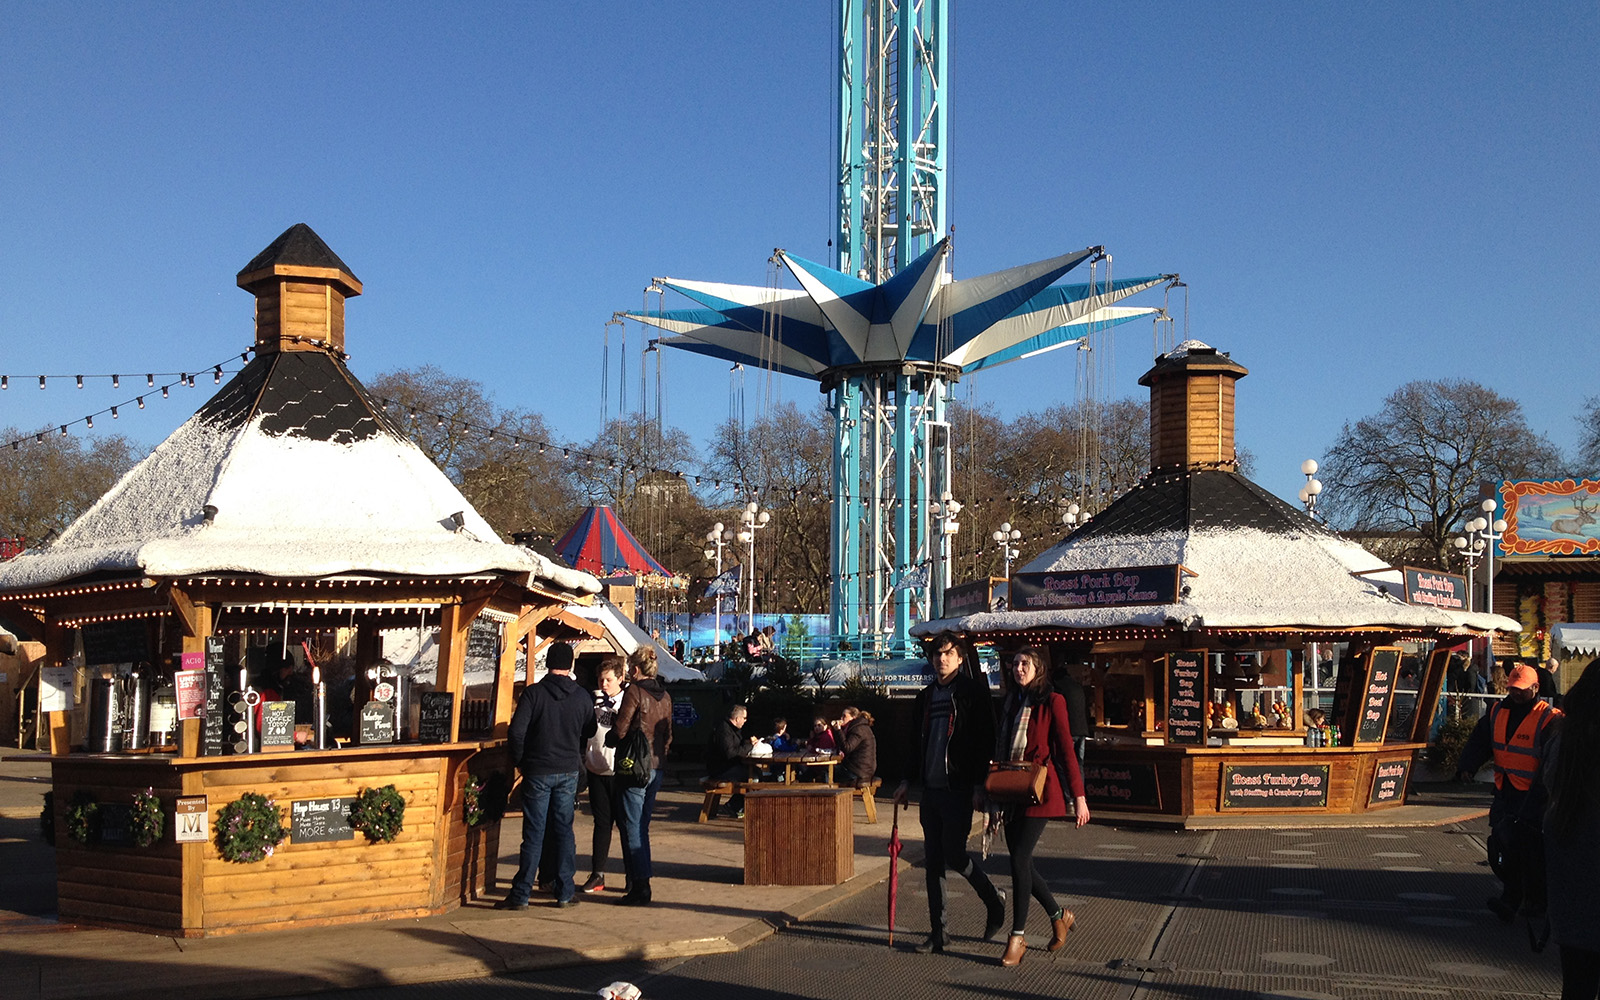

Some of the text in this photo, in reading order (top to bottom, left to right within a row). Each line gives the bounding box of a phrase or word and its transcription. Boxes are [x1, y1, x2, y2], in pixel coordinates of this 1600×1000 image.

[1044, 572, 1140, 590] Roast Pork Bap
[1417, 573, 1454, 593] Roast Pork Bap
[1026, 589, 1158, 607] with Stuffing & Apple Sauce
[1176, 659, 1197, 668] Roast
[884, 674, 897, 682] FOR
[898, 674, 911, 682] THE
[1174, 669, 1199, 678] Turkey
[1375, 671, 1388, 681] Hot
[1179, 679, 1194, 688] Bap
[379, 688, 390, 698] 13
[1178, 689, 1195, 698] with
[1369, 684, 1388, 694] Roast
[1172, 699, 1200, 708] Stuffing
[1368, 696, 1384, 707] Beef
[1366, 709, 1380, 721] Bap
[1169, 718, 1201, 728] Cranberry
[268, 727, 286, 735] 7.00
[1176, 728, 1196, 736] Sauce
[1101, 768, 1131, 780] Roast
[1232, 773, 1322, 787] Roast Turkey Bap
[1086, 784, 1132, 799] Beef Bap
[1229, 789, 1244, 797] with
[1244, 788, 1268, 797] Stuffing
[1274, 788, 1303, 798] Cranberry
[1304, 788, 1322, 796] Sauce
[177, 798, 205, 806] Presented
[294, 802, 308, 817] Hop
[331, 799, 341, 810] 13
[182, 814, 203, 834] M
[299, 826, 325, 837] MORE
